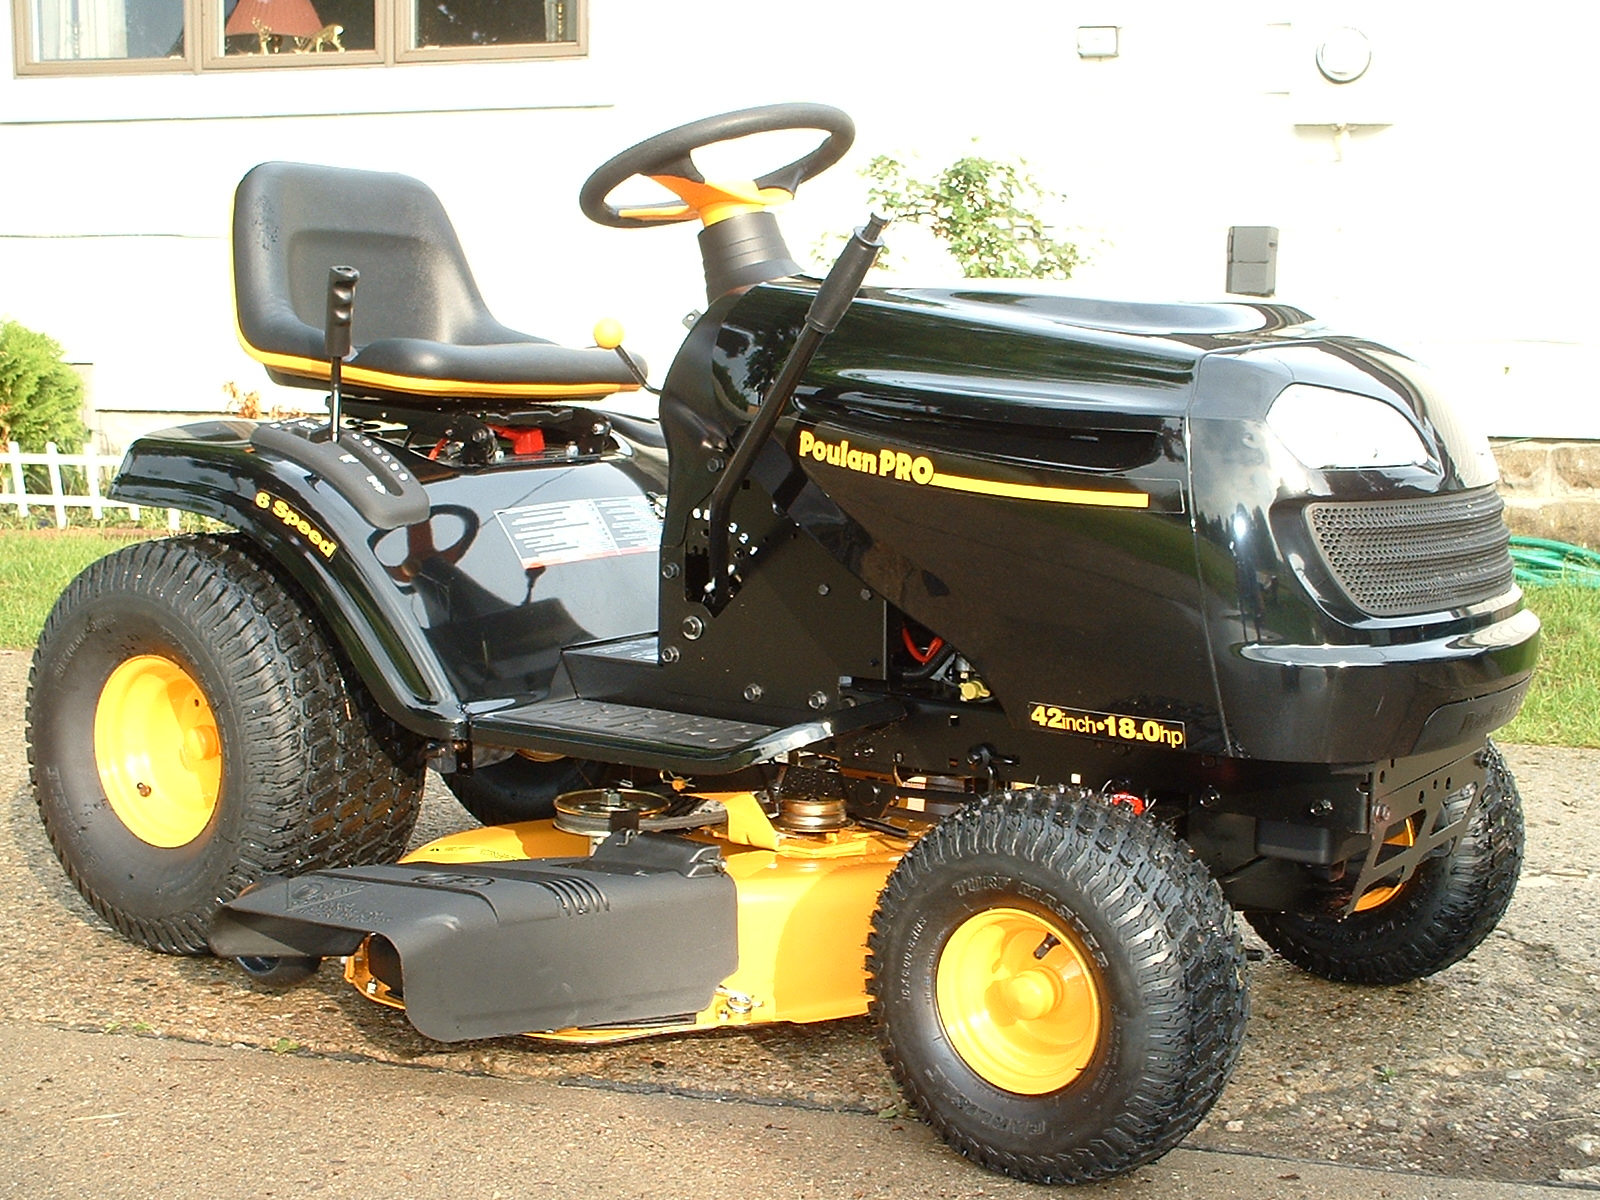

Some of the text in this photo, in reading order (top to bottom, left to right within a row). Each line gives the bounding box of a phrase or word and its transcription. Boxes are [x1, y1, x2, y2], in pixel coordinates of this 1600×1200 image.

[798, 430, 934, 485] Poulan PRO
[255, 492, 337, 558] 6 Speed
